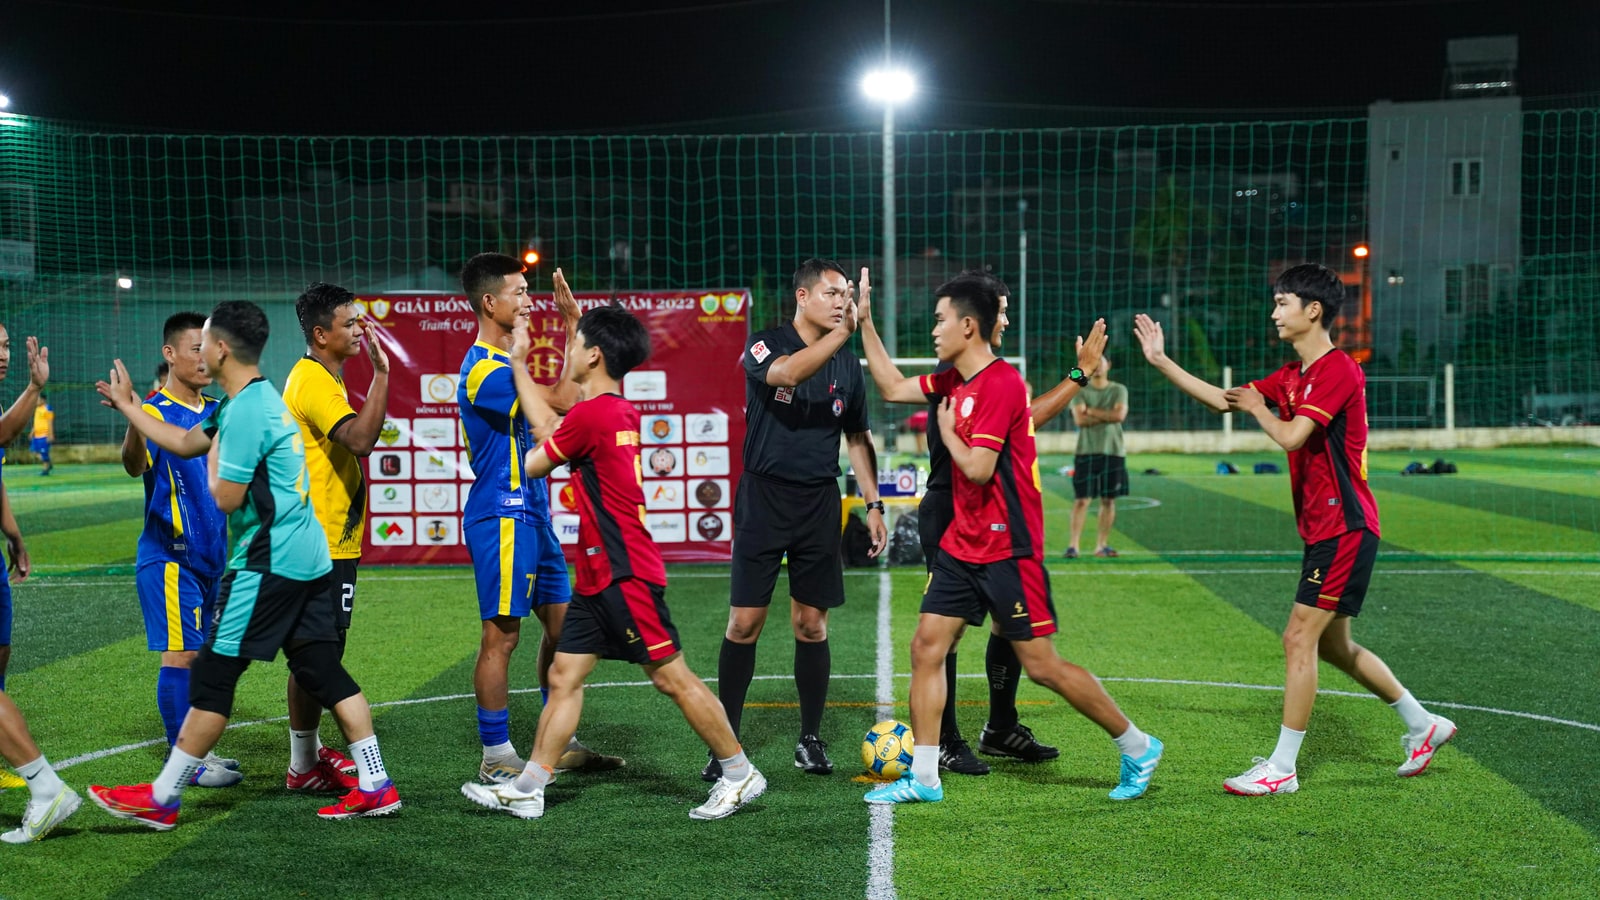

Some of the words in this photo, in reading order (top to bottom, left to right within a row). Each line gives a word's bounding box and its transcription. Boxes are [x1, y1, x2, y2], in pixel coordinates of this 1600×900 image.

[394, 297, 431, 313] GIẢI
[656, 297, 695, 310] 2022
[453, 318, 475, 334] Cúp
